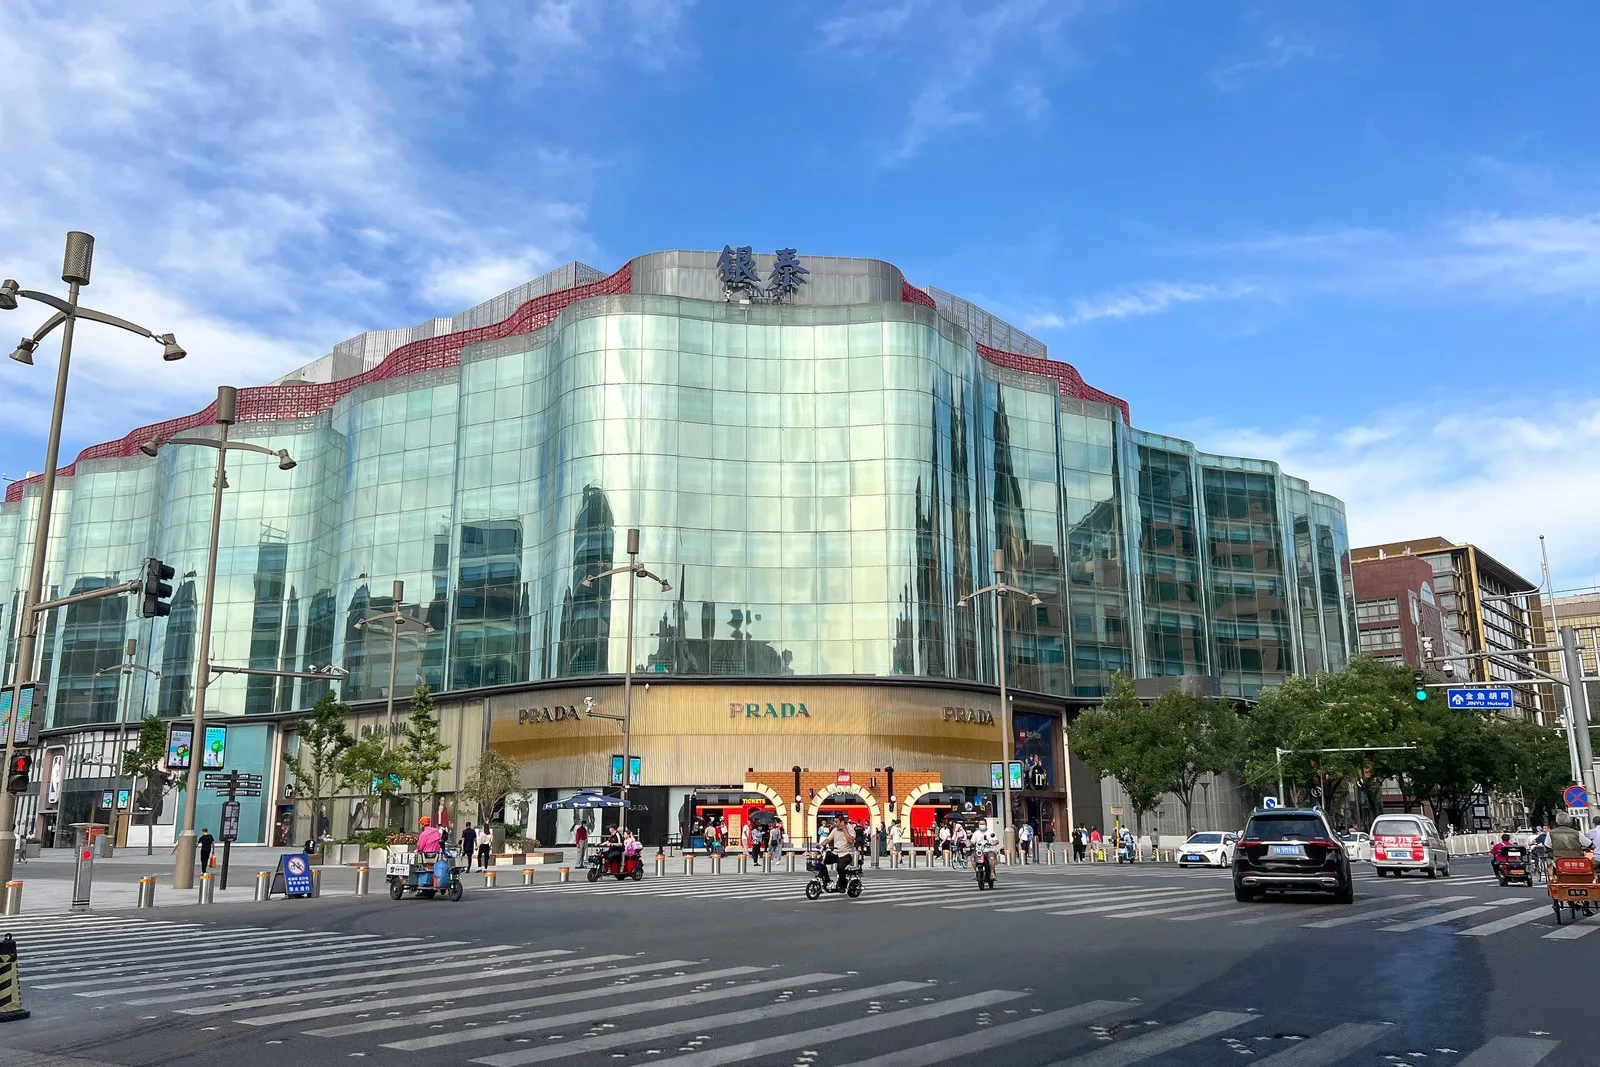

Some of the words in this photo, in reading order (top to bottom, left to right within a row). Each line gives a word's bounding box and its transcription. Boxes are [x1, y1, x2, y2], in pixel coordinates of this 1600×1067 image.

[717, 245, 810, 287] 银泰
[1465, 692, 1509, 700] 金鱼胡同
[519, 705, 582, 724] PRADA
[730, 702, 810, 718] PRADA
[943, 706, 995, 726] PRADA
